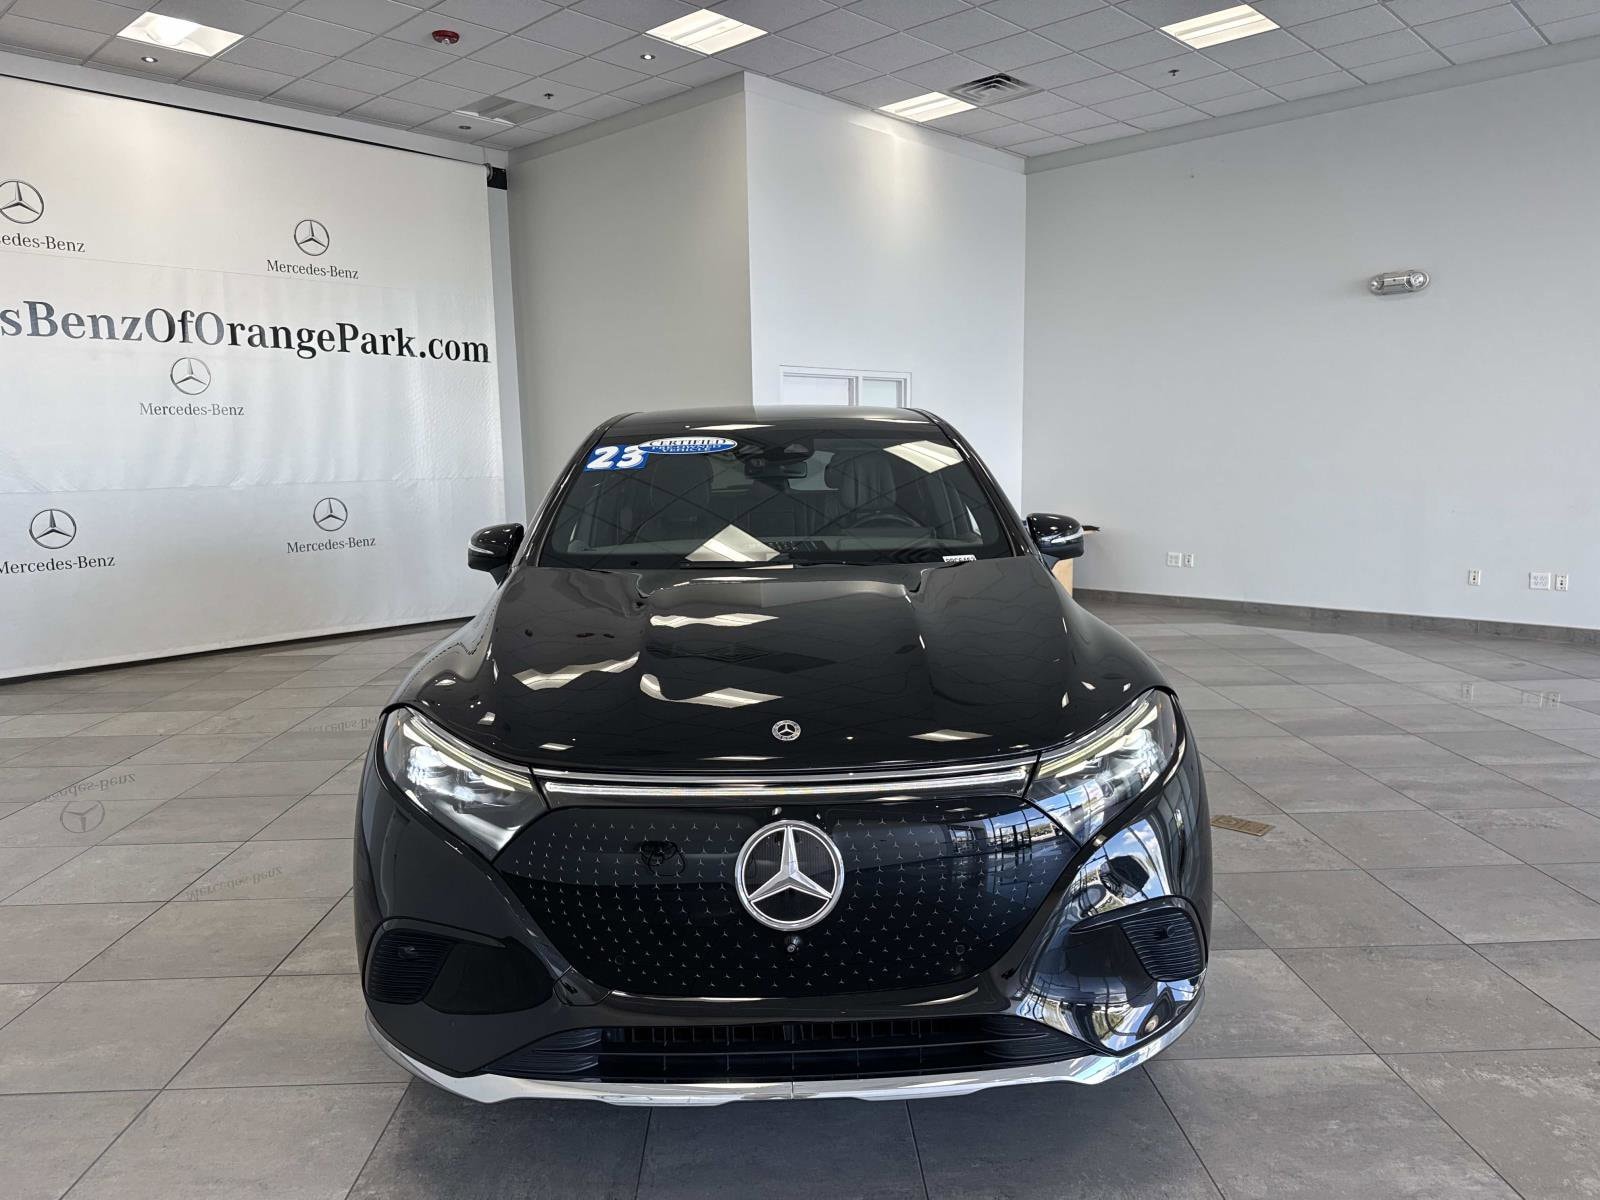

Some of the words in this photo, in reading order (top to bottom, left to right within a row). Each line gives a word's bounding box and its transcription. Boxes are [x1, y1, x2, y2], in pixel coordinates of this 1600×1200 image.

[0, 232, 86, 254] edes-Benz
[266, 260, 360, 280] Mercedes-Benz
[139, 402, 246, 417] Mercedes-Benz
[586, 445, 645, 470] 23
[286, 536, 377, 554] Mercedes-Benz
